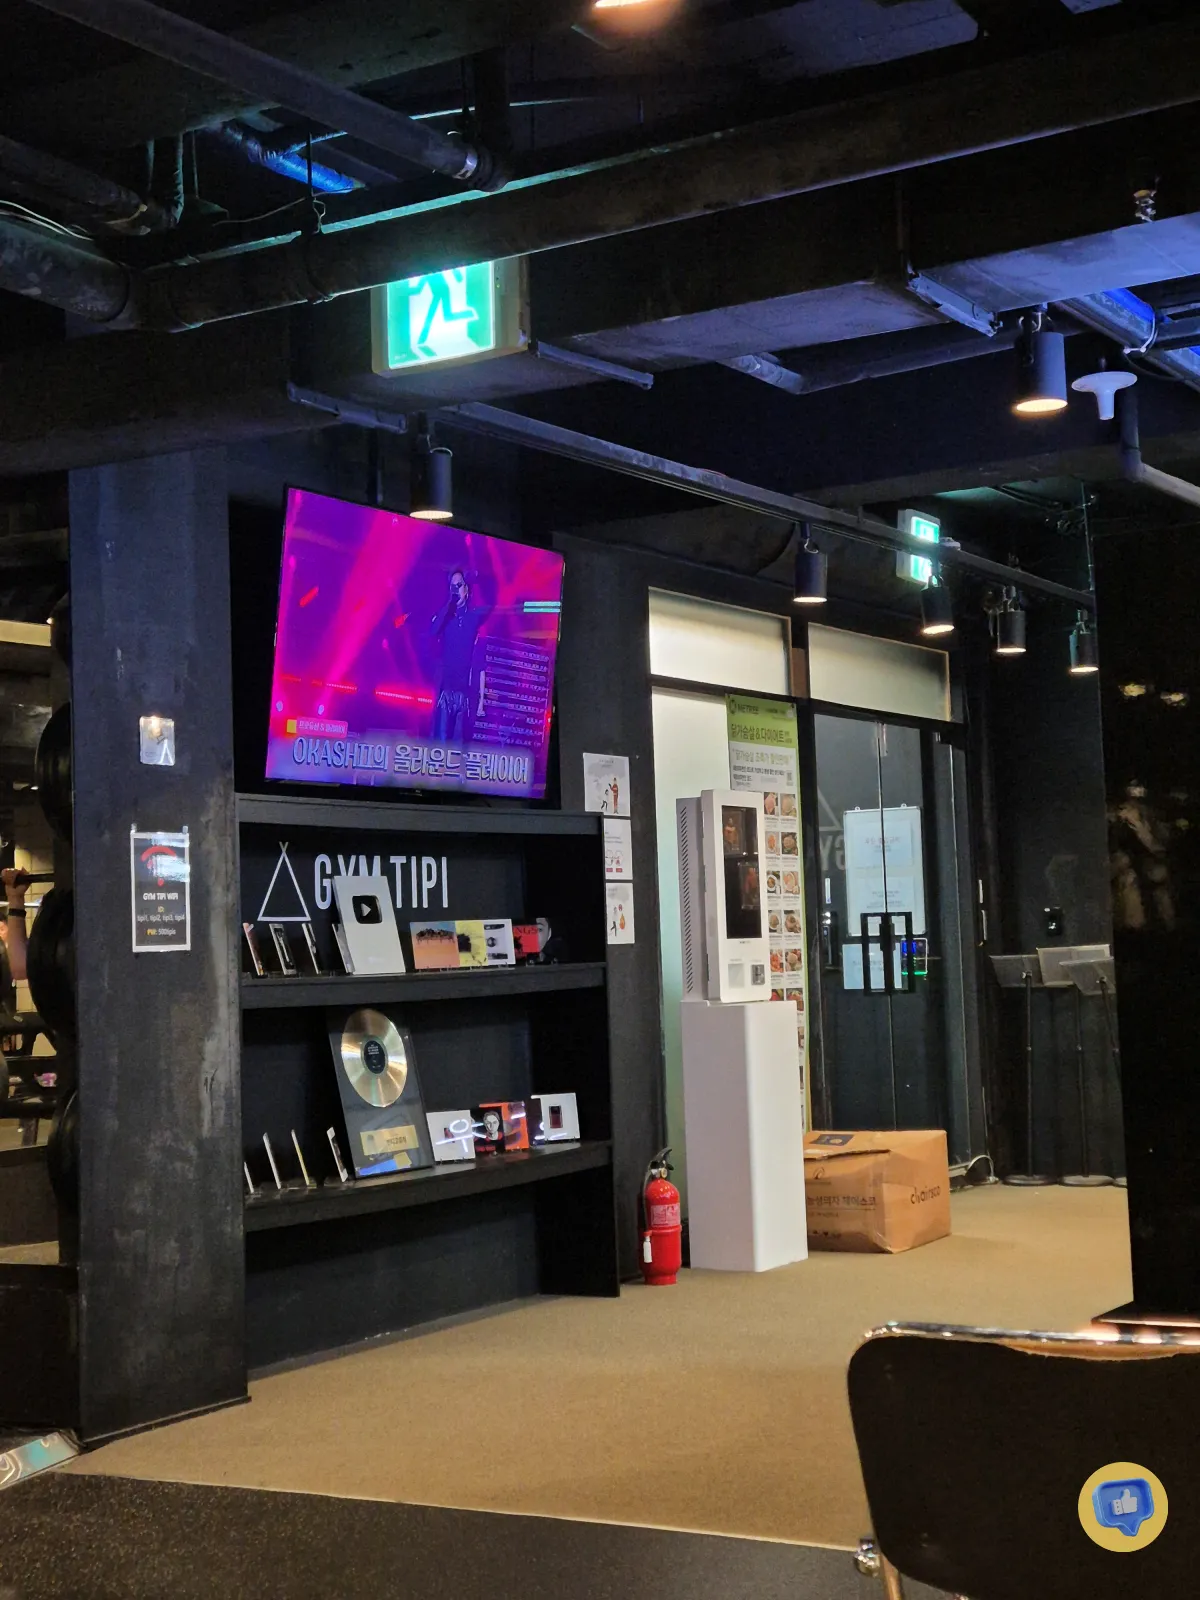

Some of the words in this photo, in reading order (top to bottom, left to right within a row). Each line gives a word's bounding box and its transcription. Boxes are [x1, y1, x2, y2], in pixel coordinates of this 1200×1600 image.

[394, 744, 462, 776] 올라운드
[465, 751, 529, 783] 플레이어
[389, 855, 449, 909] TIPI
